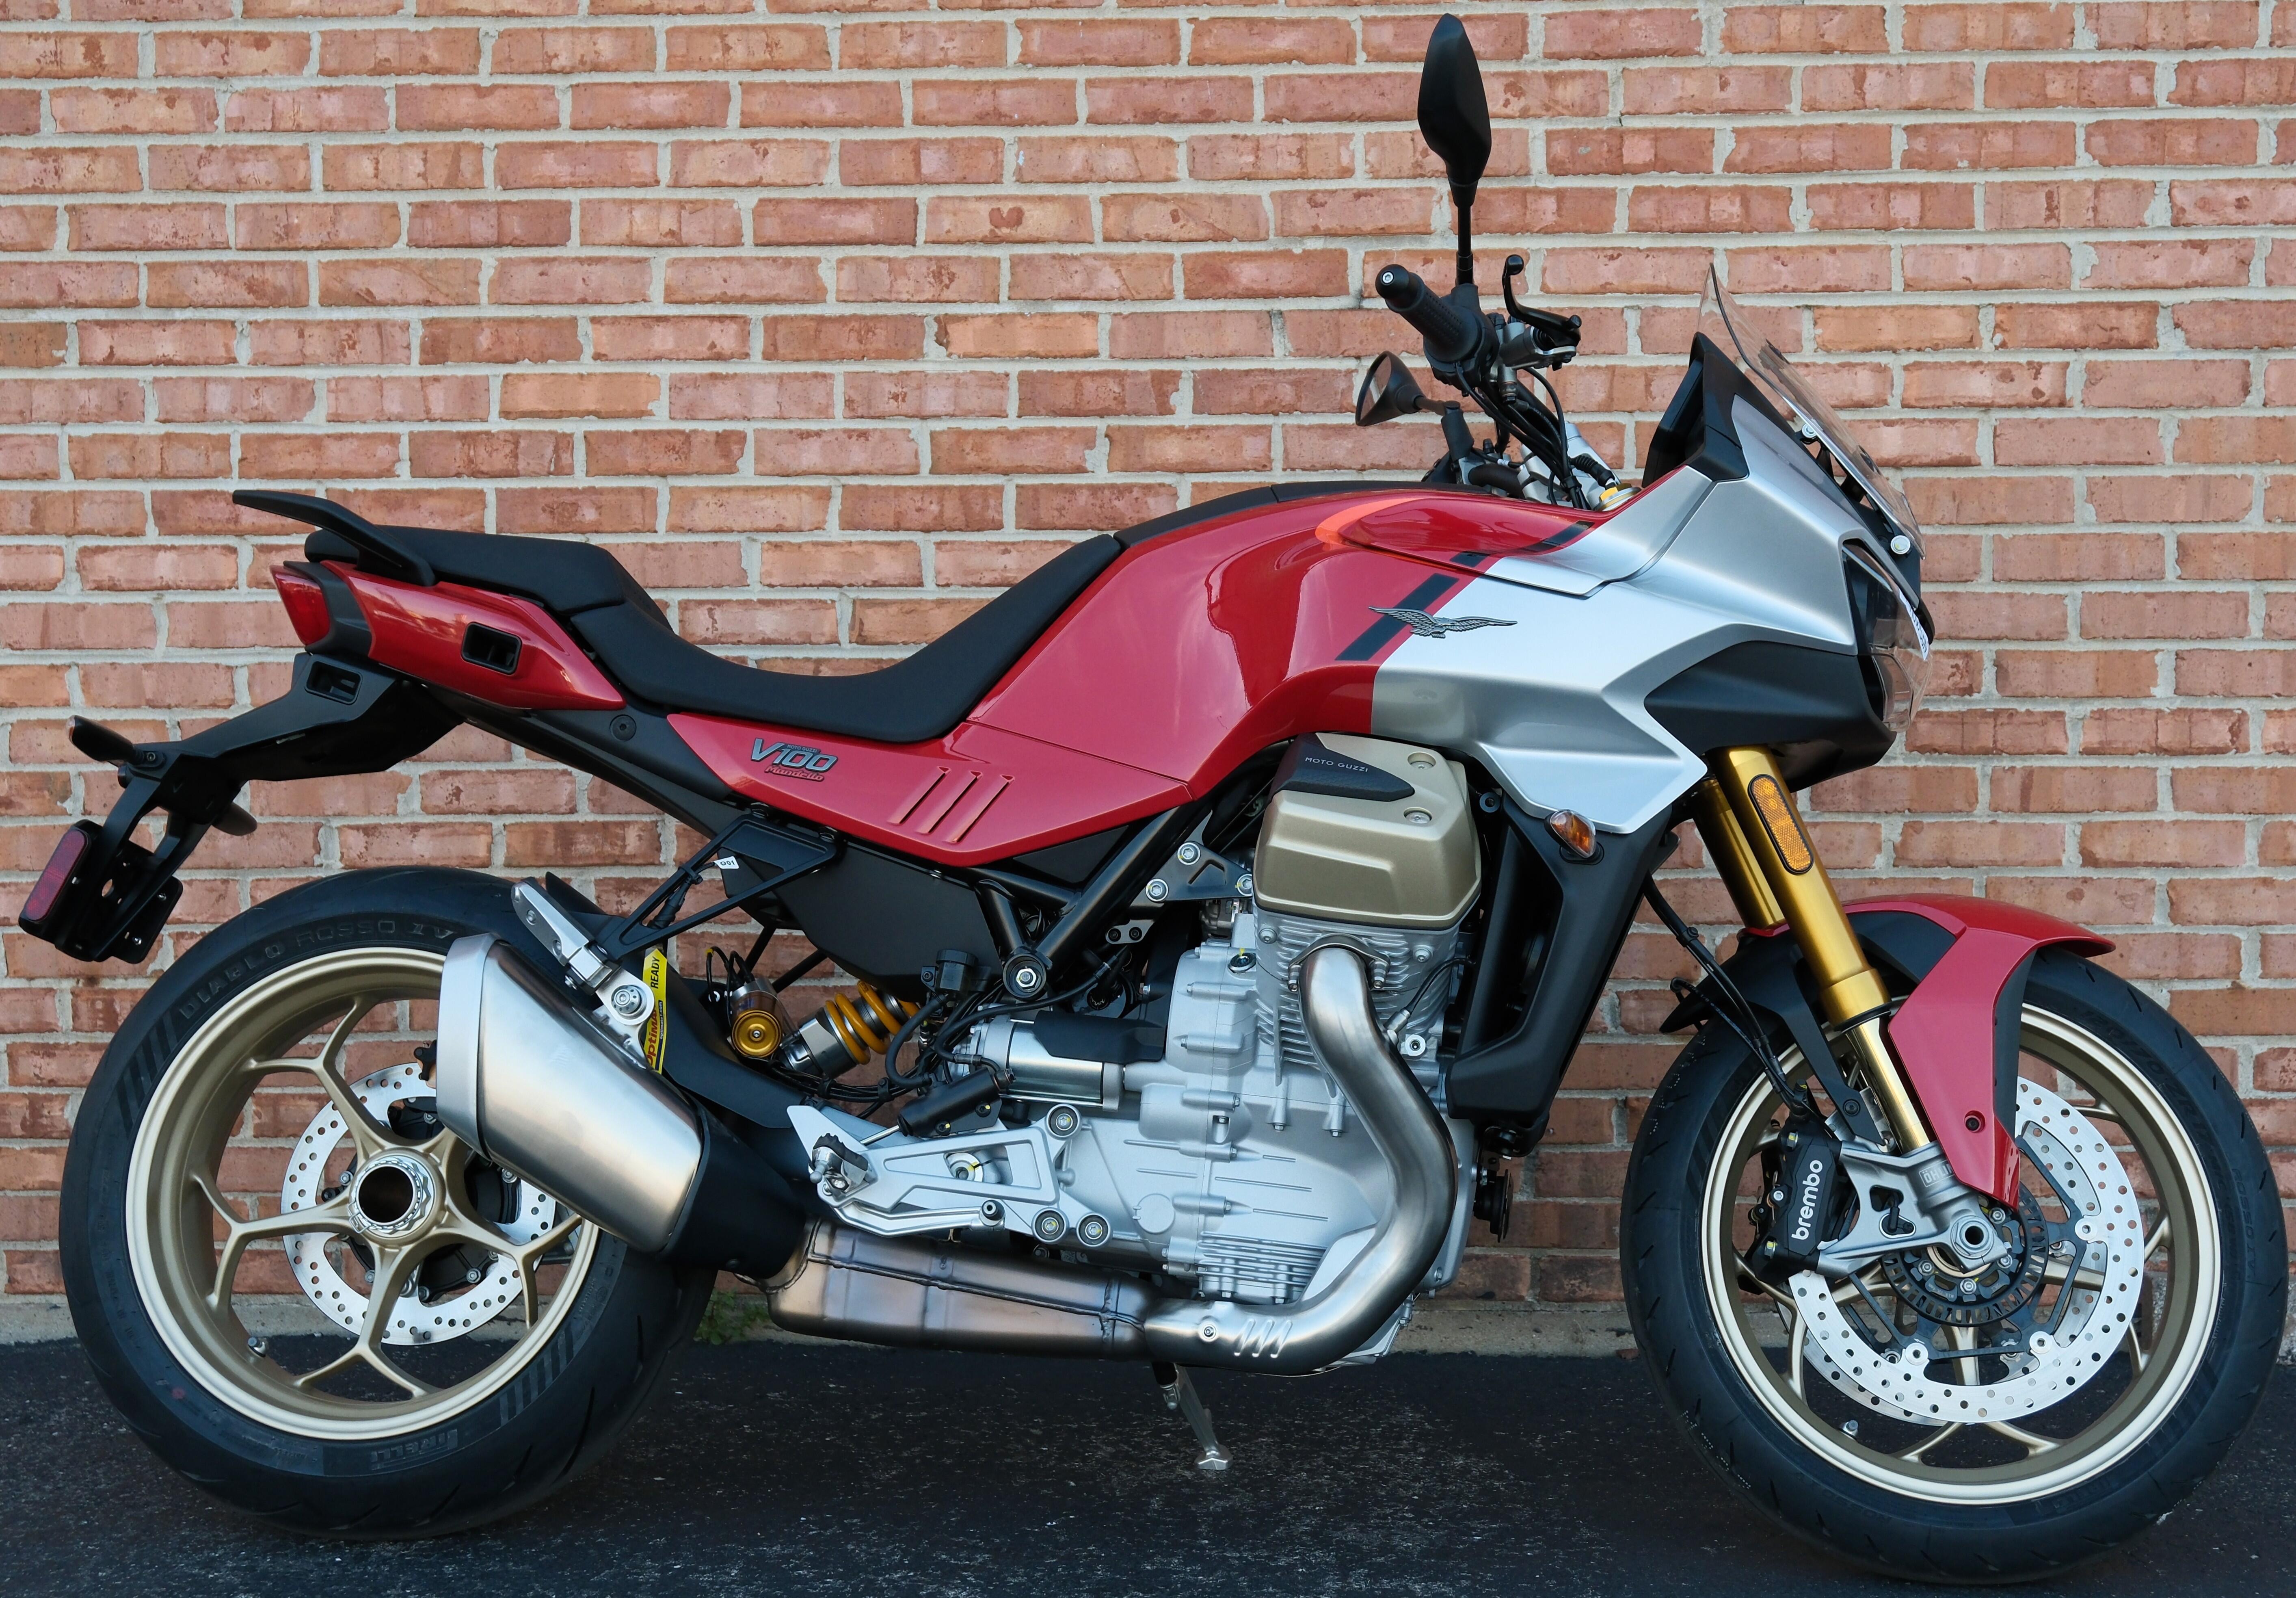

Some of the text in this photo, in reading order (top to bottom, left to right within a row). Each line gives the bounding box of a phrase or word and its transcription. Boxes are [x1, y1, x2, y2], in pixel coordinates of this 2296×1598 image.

[751, 738, 838, 772] V100
[1305, 757, 1368, 772] MOTO GUZZI
[765, 766, 824, 782] Mandello
[179, 944, 283, 1020] DIABLO
[297, 920, 396, 947] ROSSO
[651, 956, 660, 989] READY
[1922, 1163, 1952, 1183] ÖHLI
[1791, 1160, 1823, 1240] brembo
[2232, 1168, 2254, 1240] ROSSO
